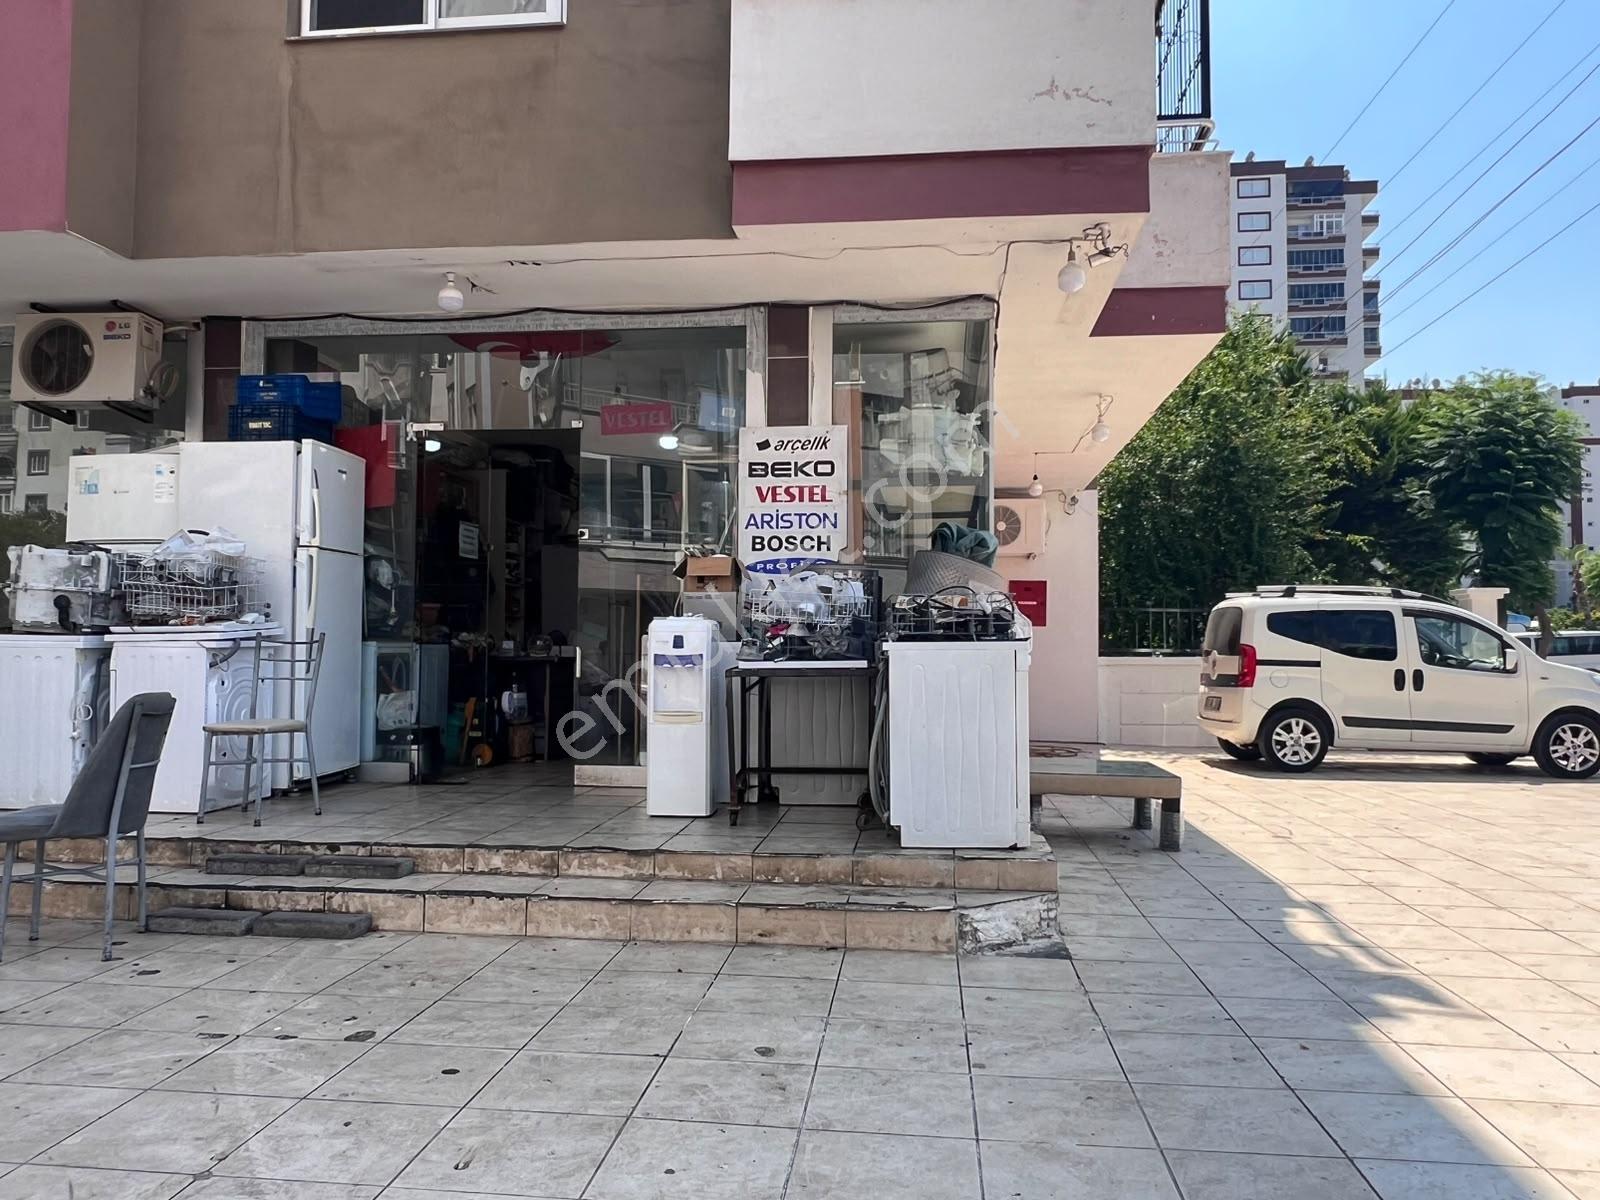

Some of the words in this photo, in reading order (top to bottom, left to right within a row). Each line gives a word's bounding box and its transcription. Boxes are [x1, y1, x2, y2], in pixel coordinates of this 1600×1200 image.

[604, 409, 667, 428] VESTEL
[748, 460, 835, 478] BEKO
[755, 485, 833, 503] VESTEL
[751, 535, 831, 552] BOSCH
[756, 560, 826, 571] PROFI
